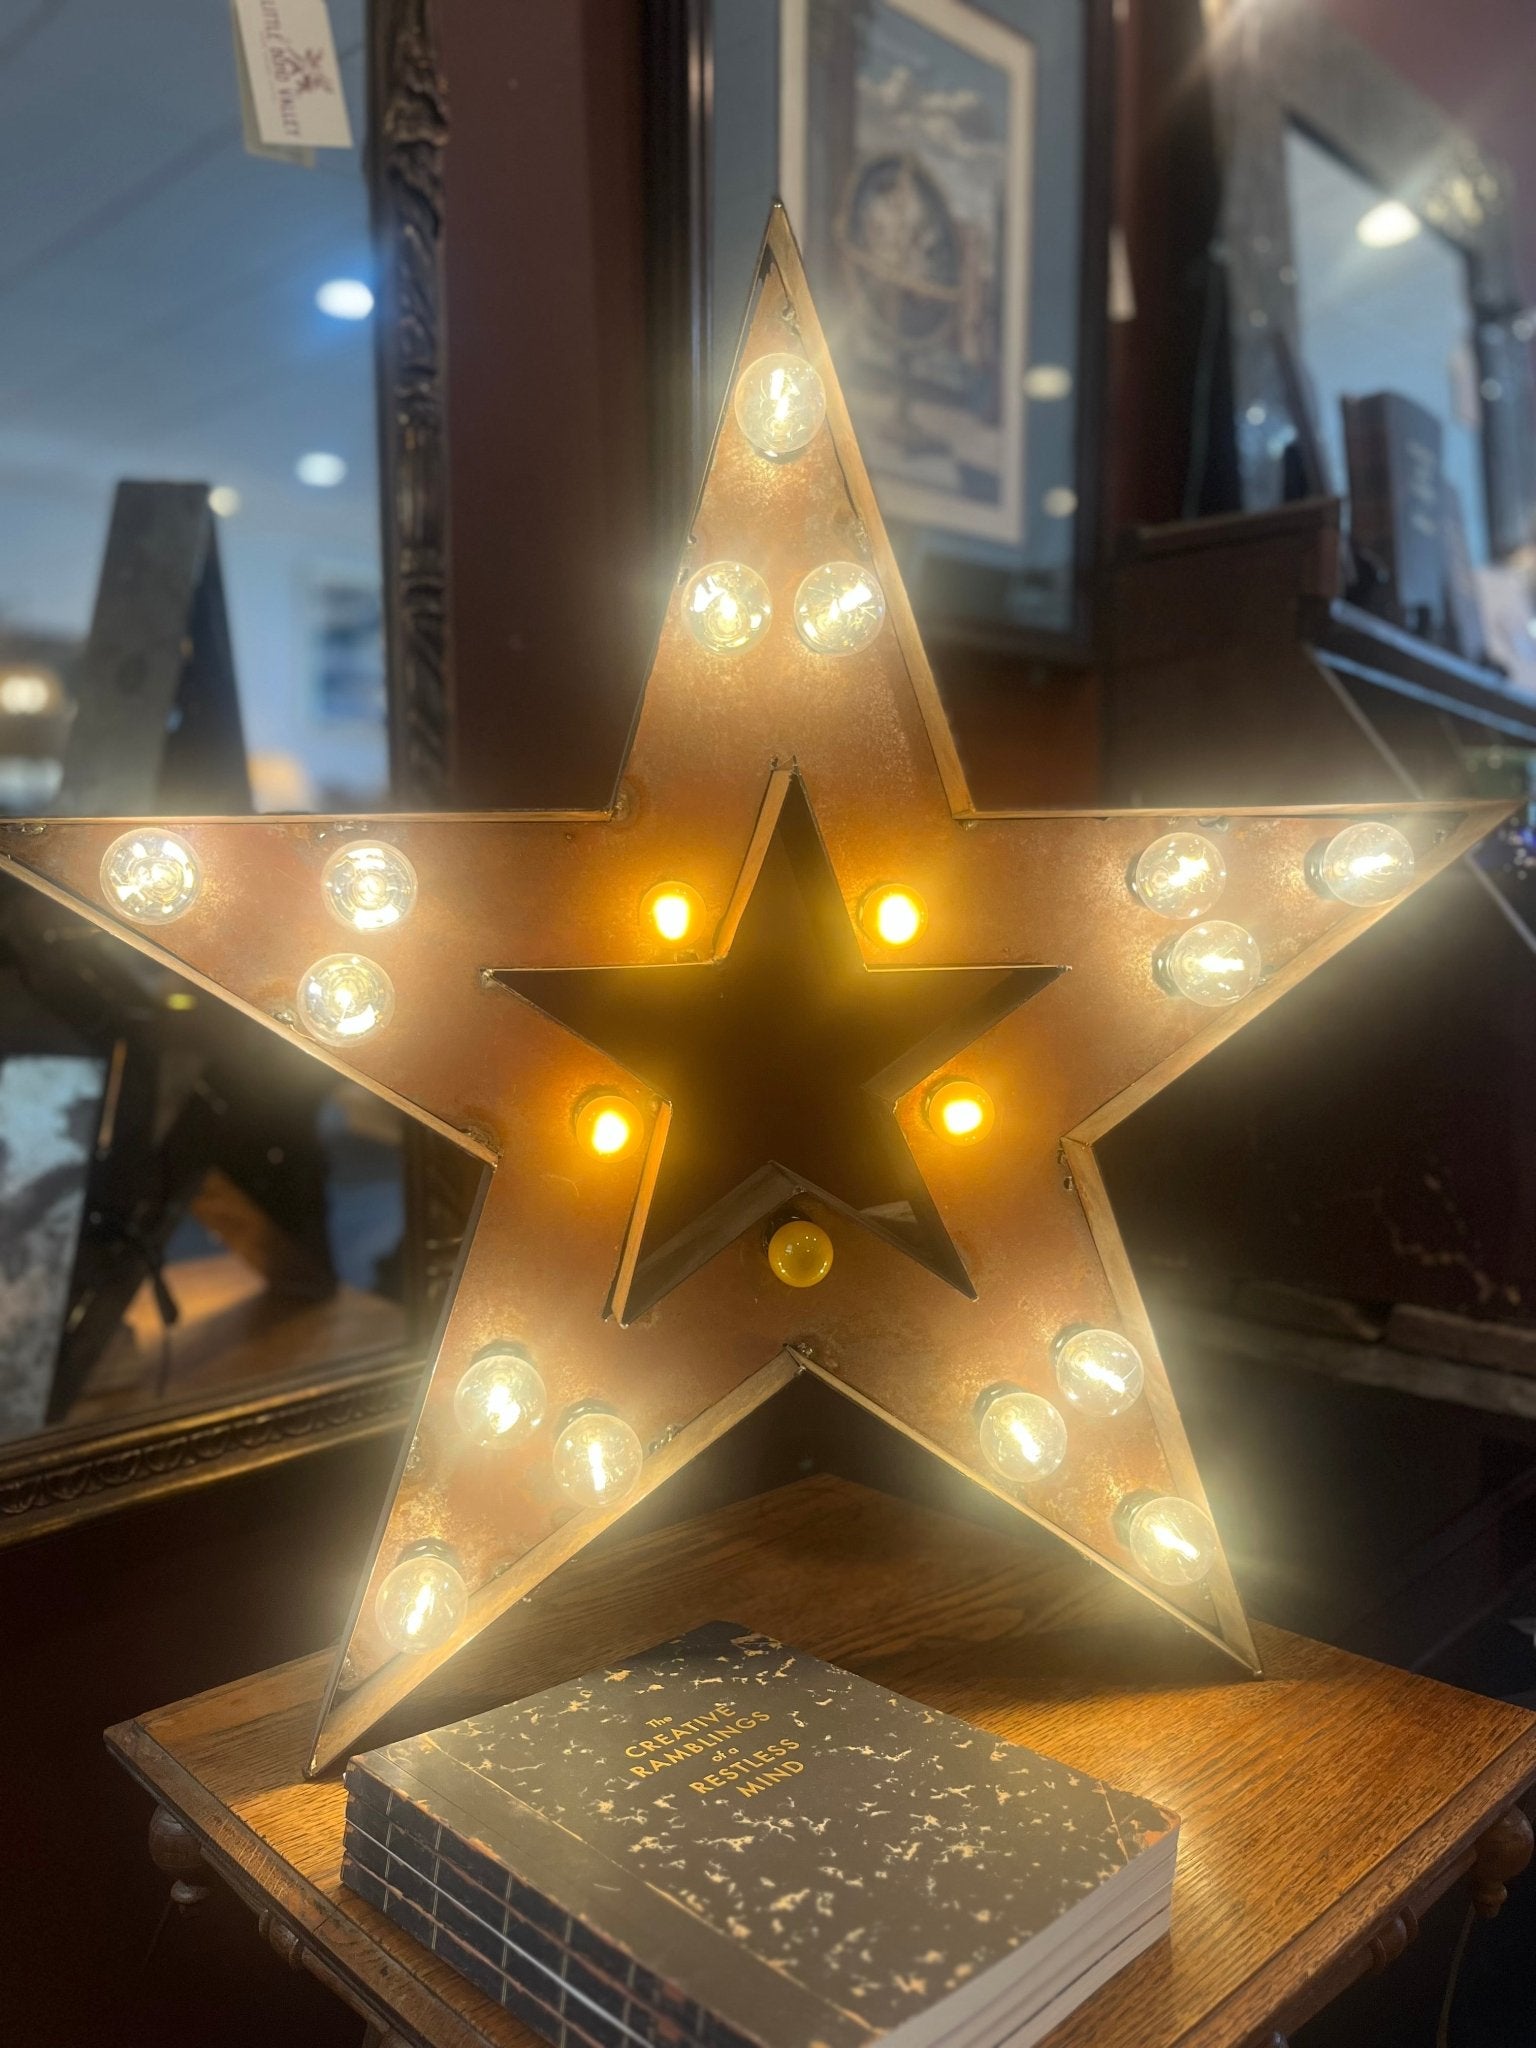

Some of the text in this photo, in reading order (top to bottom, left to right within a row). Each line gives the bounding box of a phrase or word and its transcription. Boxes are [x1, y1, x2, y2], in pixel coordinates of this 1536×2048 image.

[625, 1705, 736, 1758] CREATIVE
[629, 1711, 770, 1778] RAMBLINGS
[645, 1716, 673, 1729] The
[688, 1738, 800, 1794] RESTLESS
[711, 1747, 739, 1762] of a
[736, 1760, 804, 1798] MIND
